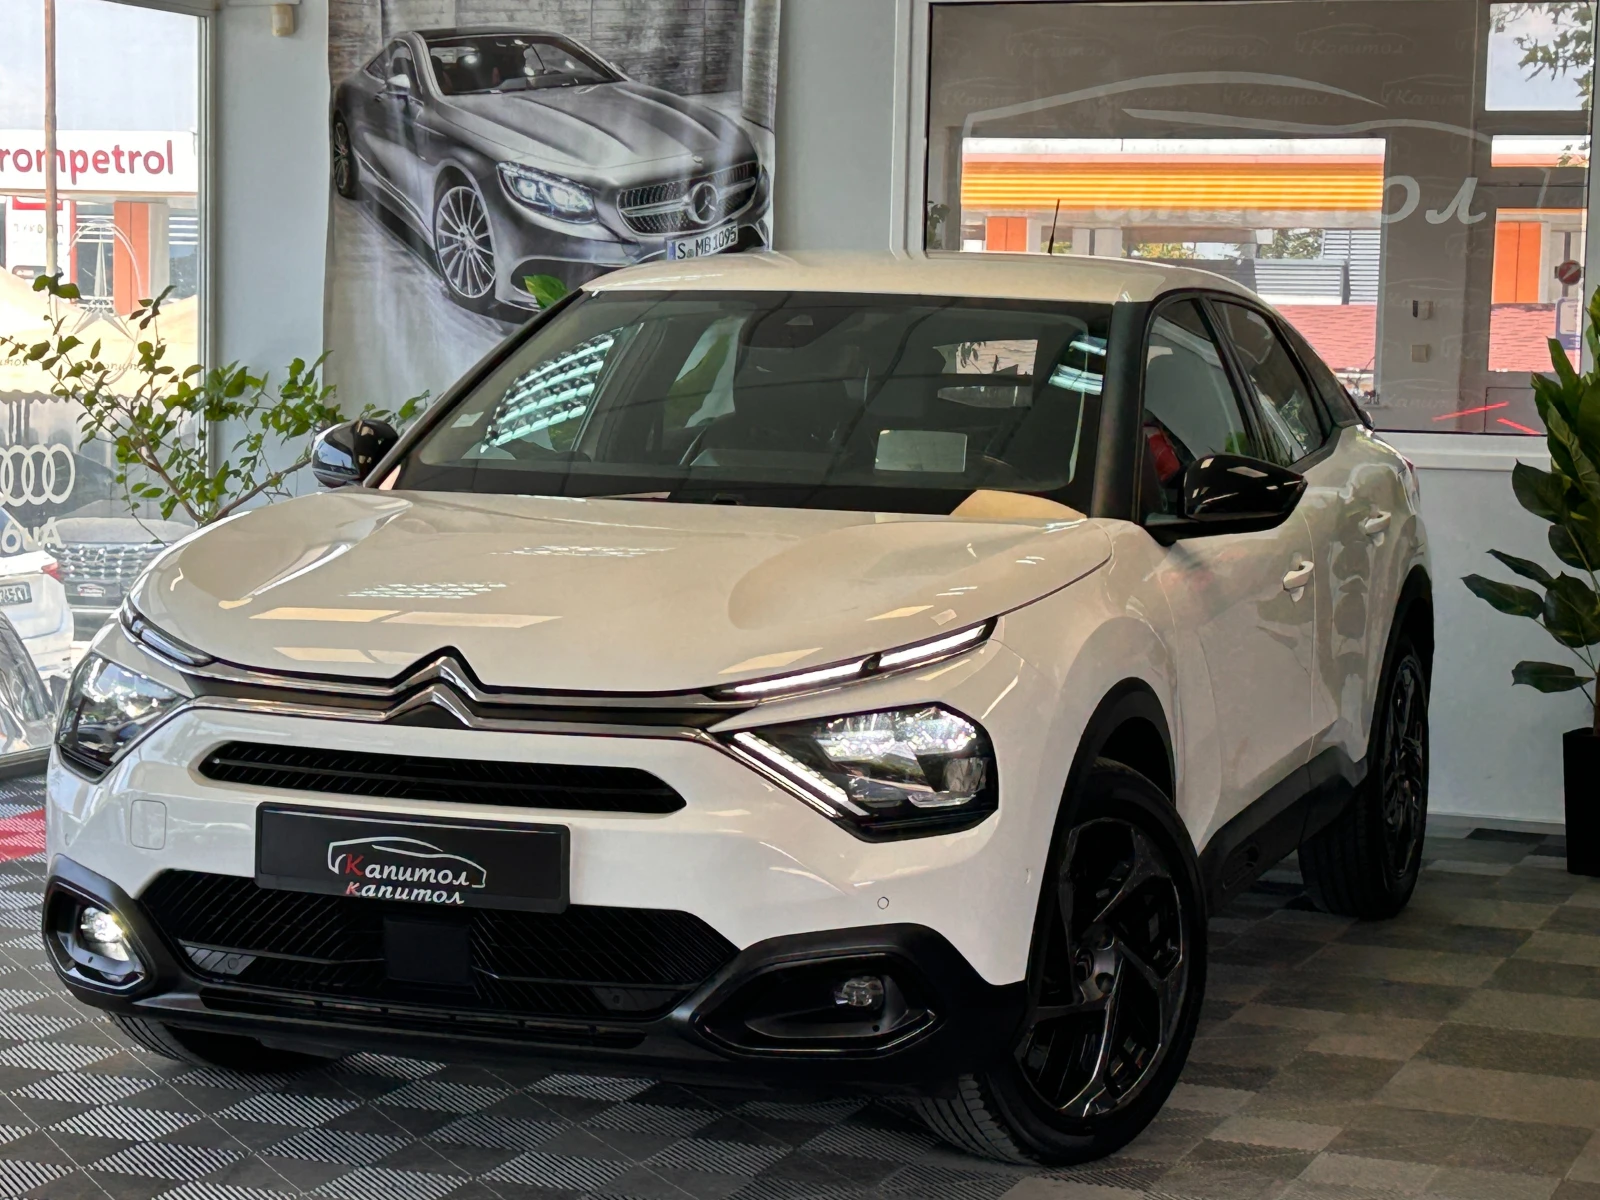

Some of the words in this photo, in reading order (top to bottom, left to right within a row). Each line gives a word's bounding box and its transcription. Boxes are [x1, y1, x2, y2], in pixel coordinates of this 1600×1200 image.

[677, 242, 686, 260] S
[695, 236, 711, 257] MB
[712, 225, 738, 251] 1095
[345, 853, 470, 886] Капитол
